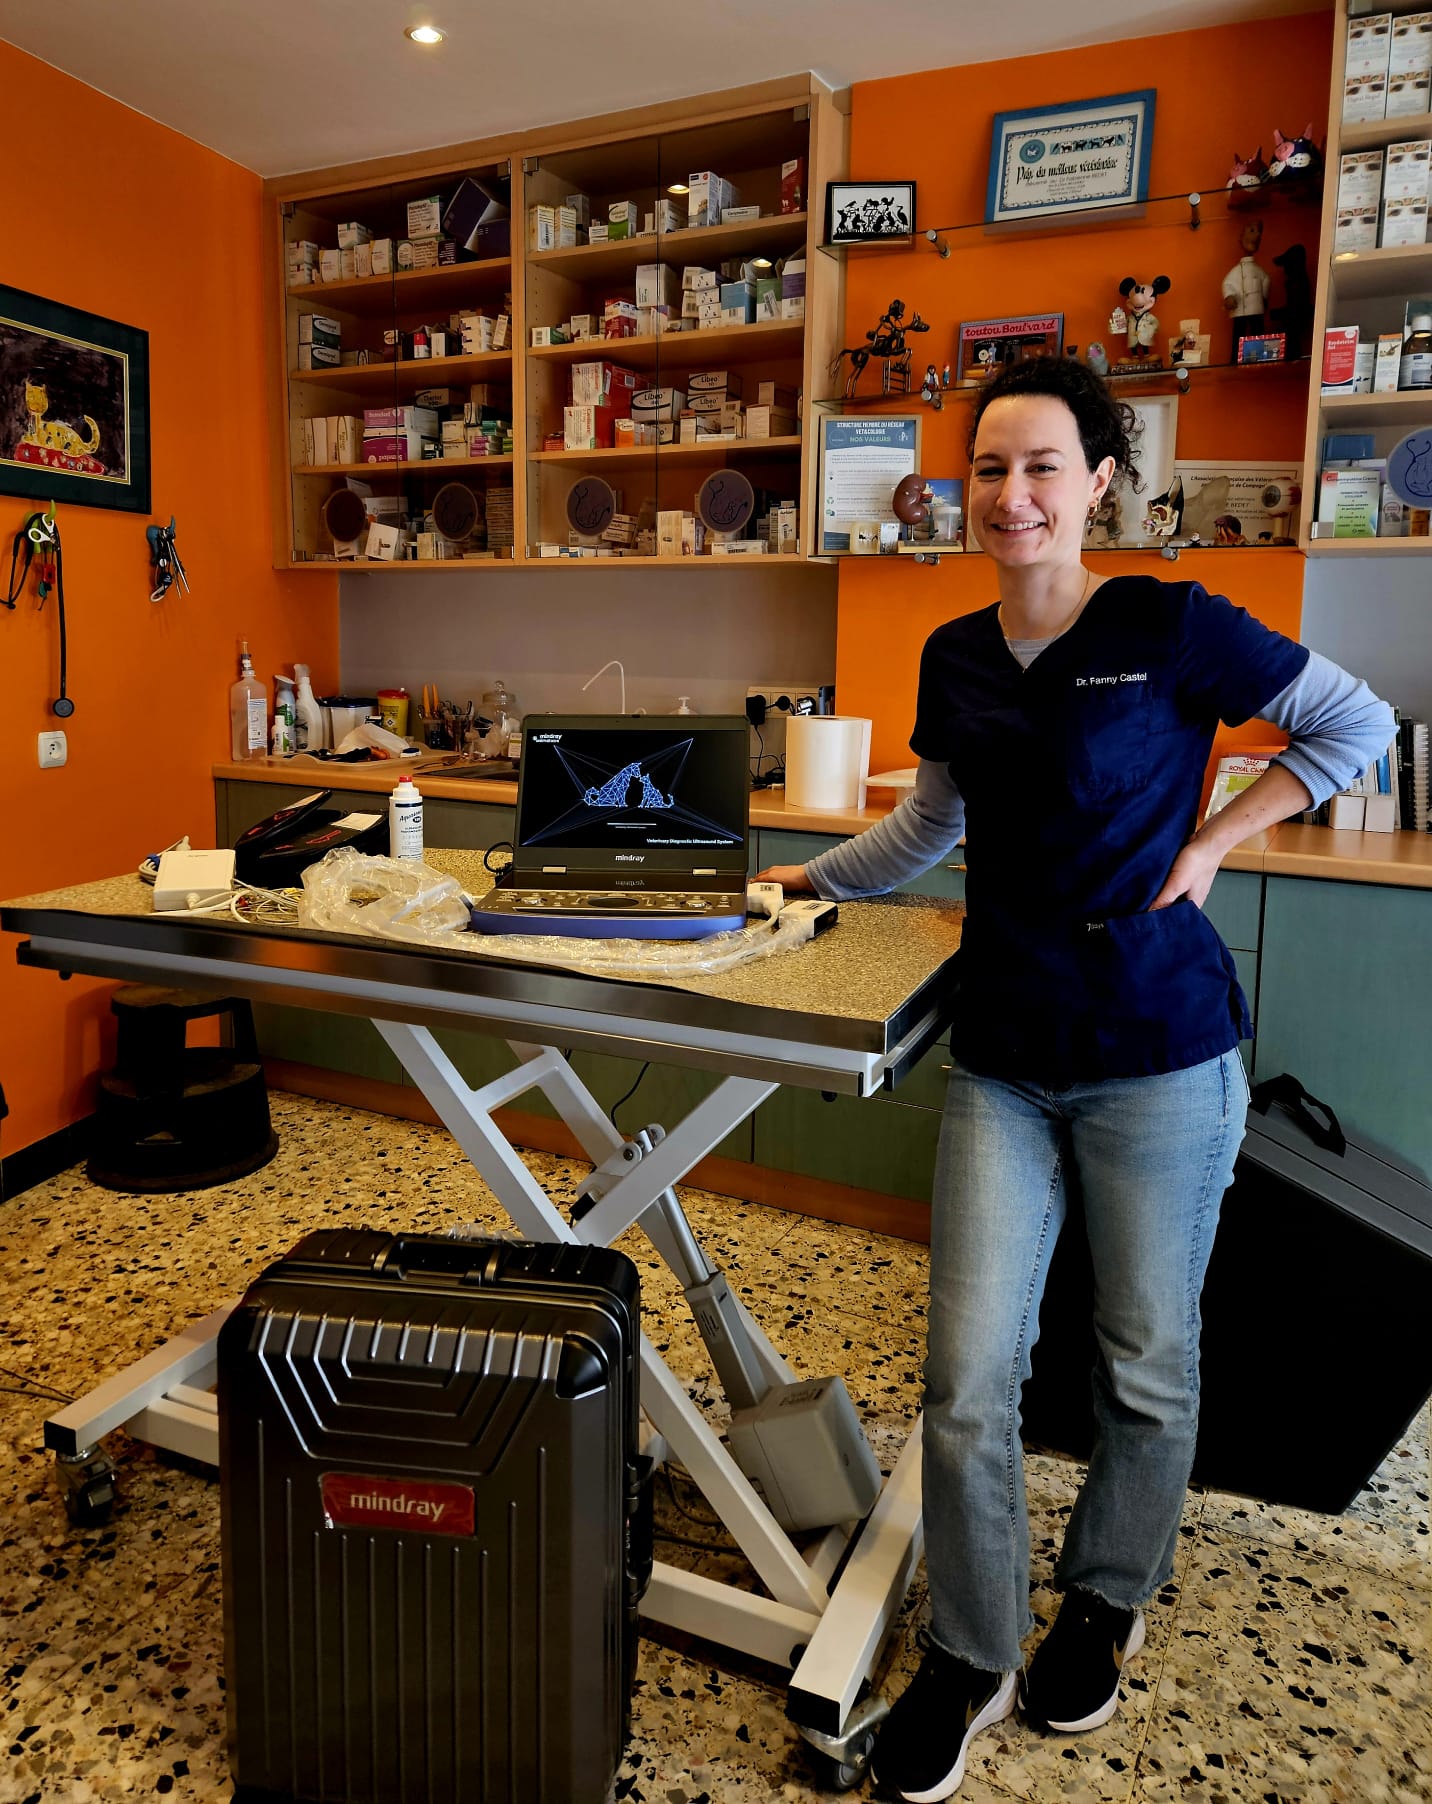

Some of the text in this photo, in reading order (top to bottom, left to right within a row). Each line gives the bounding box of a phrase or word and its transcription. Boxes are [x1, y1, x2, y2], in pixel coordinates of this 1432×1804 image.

[1036, 166, 1047, 178] du
[965, 327, 1000, 337] toutou
[701, 375, 718, 383] Libeo
[644, 393, 663, 401] Libeo
[699, 397, 717, 405] Libeo
[1076, 671, 1147, 686] Dr. Fanny Castel
[1229, 765, 1248, 773] ROYAL
[615, 854, 645, 863] mindray
[350, 1490, 445, 1523] mindray
